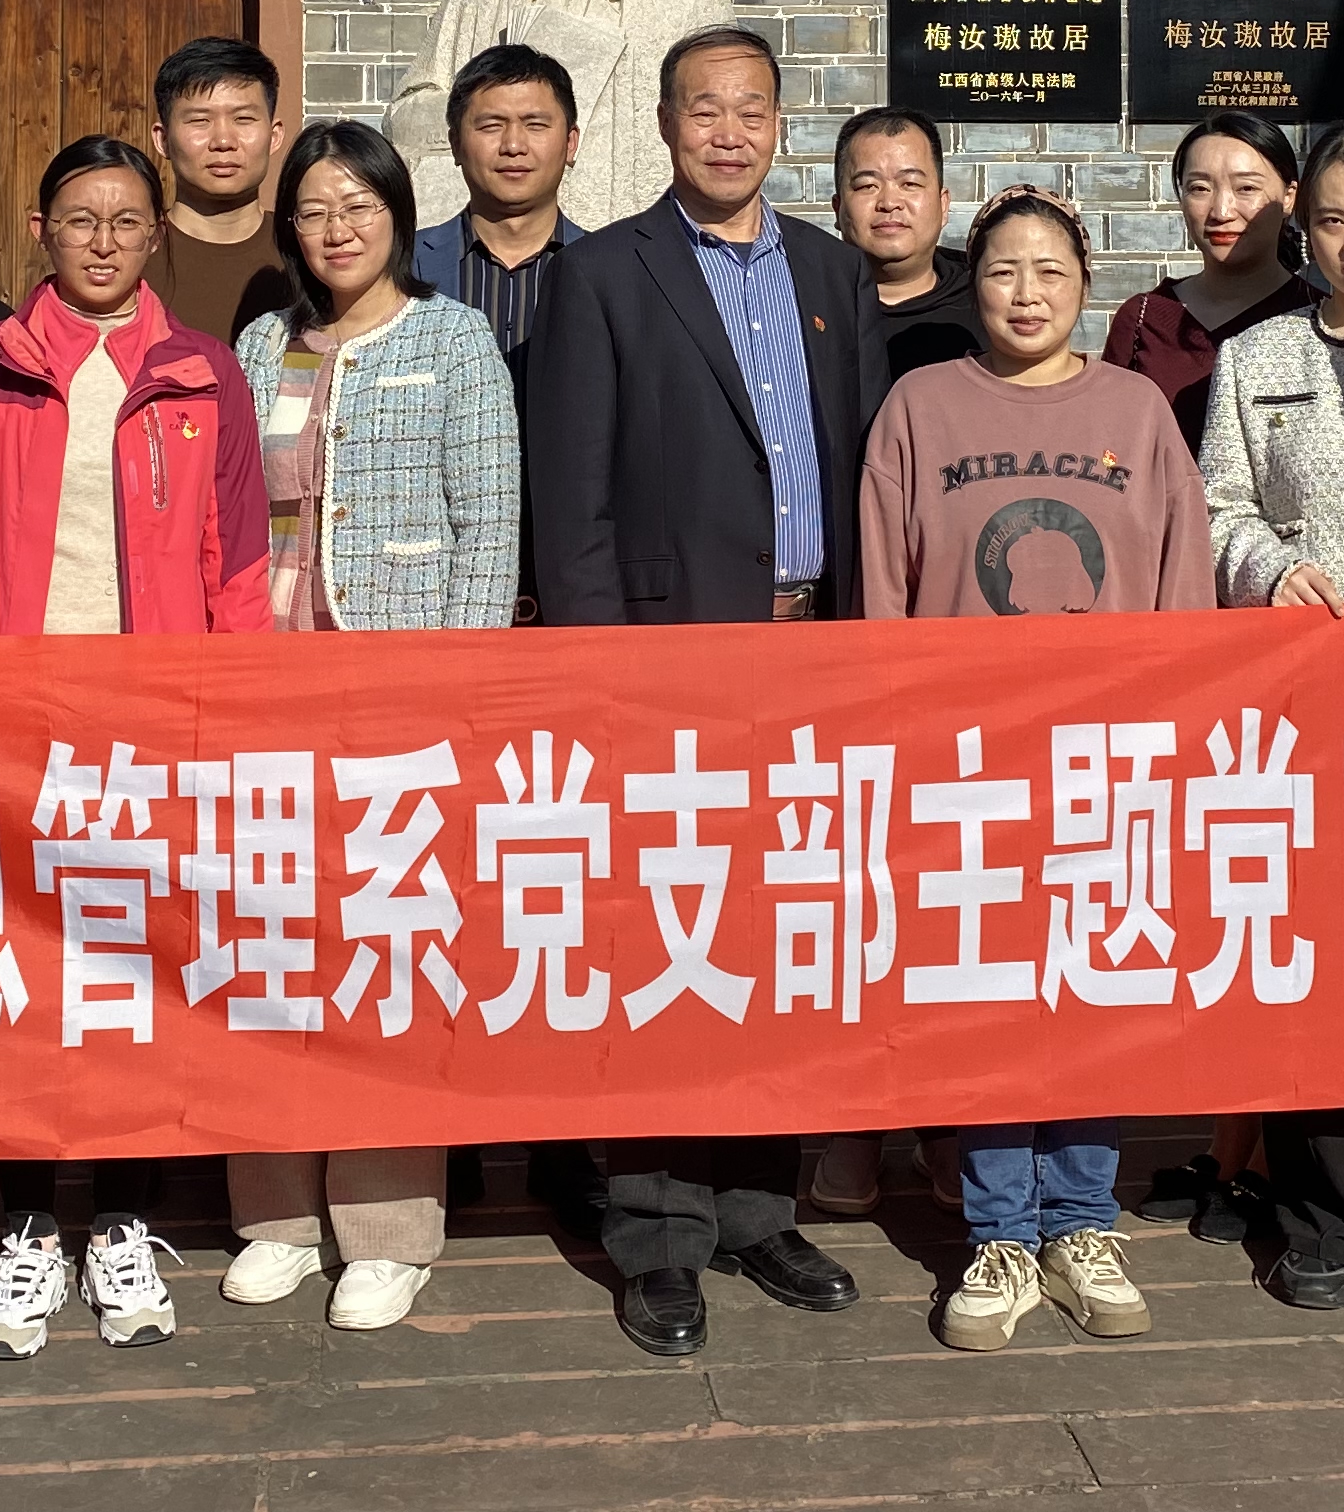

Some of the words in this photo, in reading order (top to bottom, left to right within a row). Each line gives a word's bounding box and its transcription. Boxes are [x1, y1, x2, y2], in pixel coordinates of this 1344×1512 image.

[923, 21, 1090, 51] 梅汝璈故居
[1163, 18, 1331, 50] 梅汝璈故居
[938, 72, 1076, 89] 江西省高级人民法院
[1212, 71, 1284, 83] 江西省人民政府
[1197, 95, 1299, 107] 江西省文化和旅游厅立
[939, 450, 1133, 495] MIRACLE
